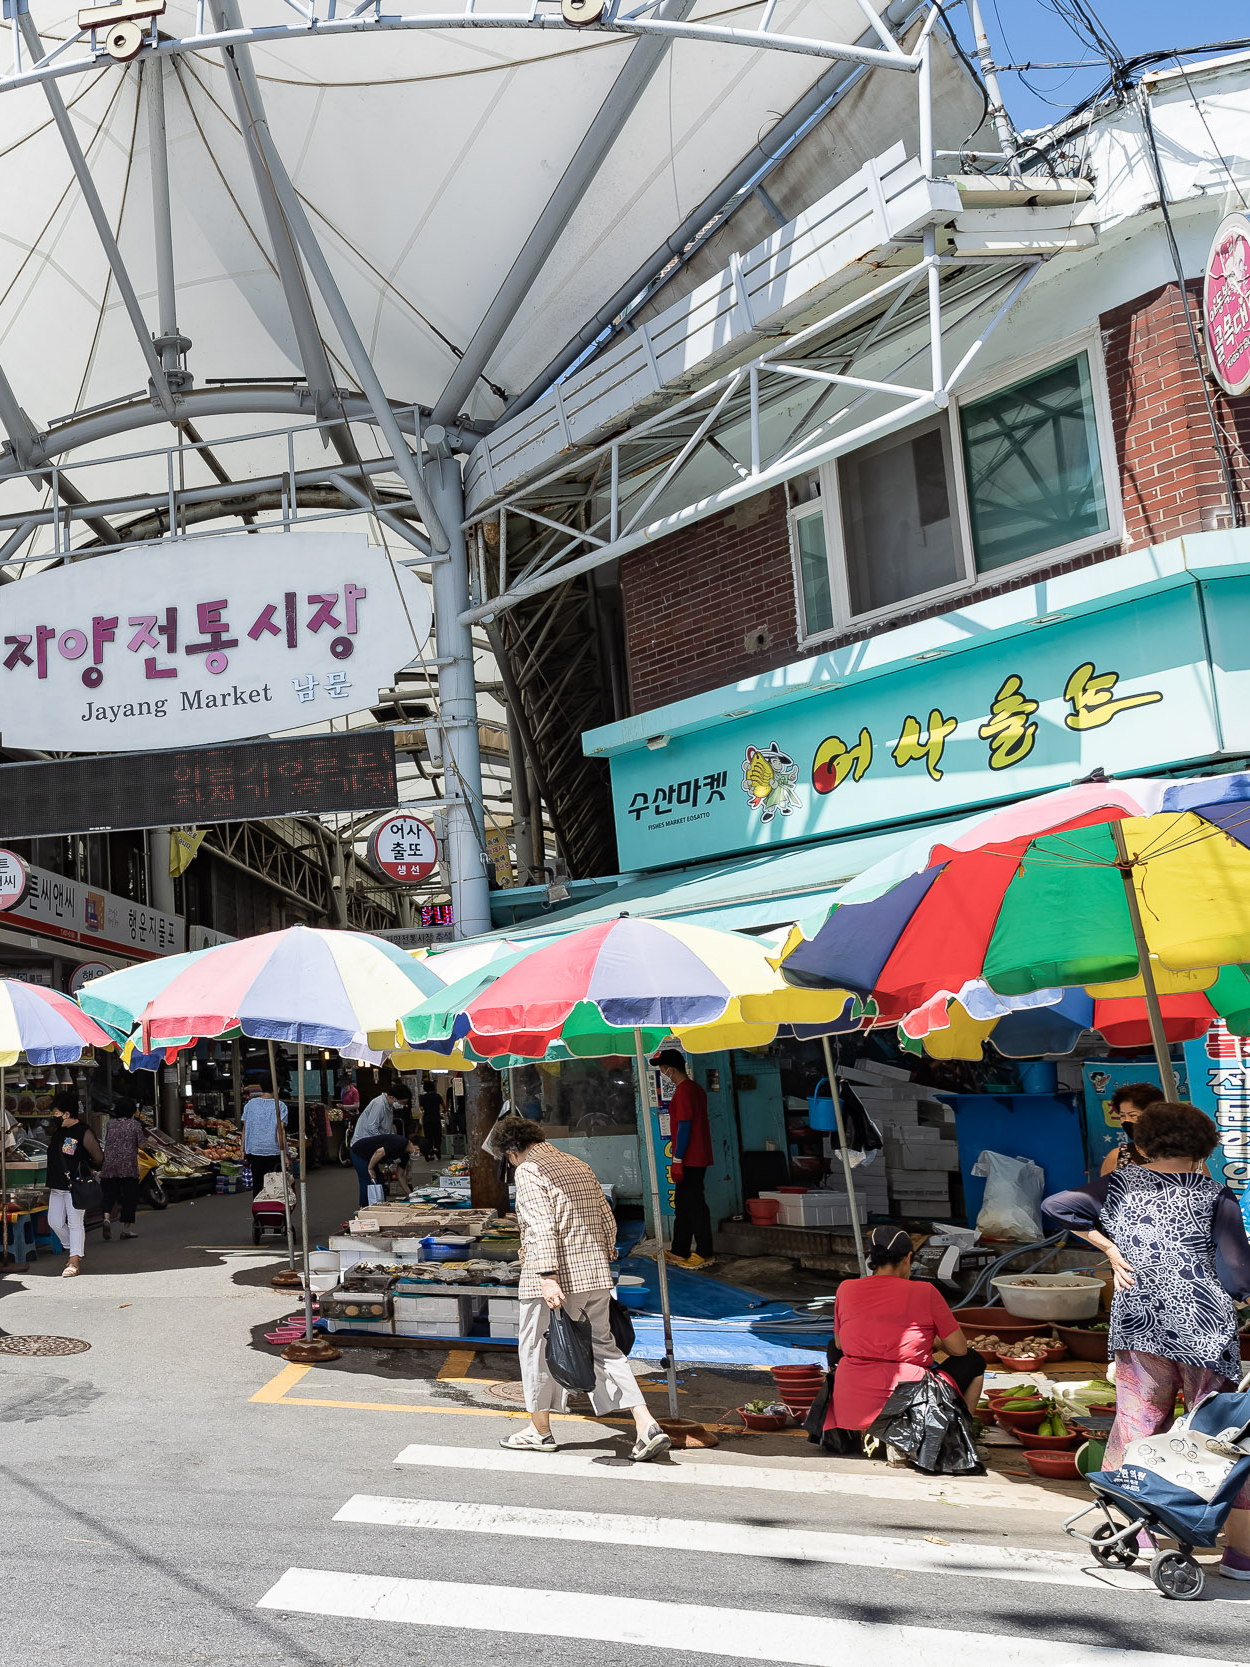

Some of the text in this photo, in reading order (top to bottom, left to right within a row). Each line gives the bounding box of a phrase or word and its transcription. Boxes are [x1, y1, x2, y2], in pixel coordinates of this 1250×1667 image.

[2, 583, 366, 688] 자양전통시장
[81, 683, 273, 723] Jayang Market
[291, 670, 352, 704] 남문
[628, 770, 728, 821] 수산마켓
[391, 823, 422, 840] 어사
[648, 811, 711, 831] FISHES MARKET EOSATTO
[391, 842, 424, 861] 출또
[128, 908, 175, 948] 행운지물포
